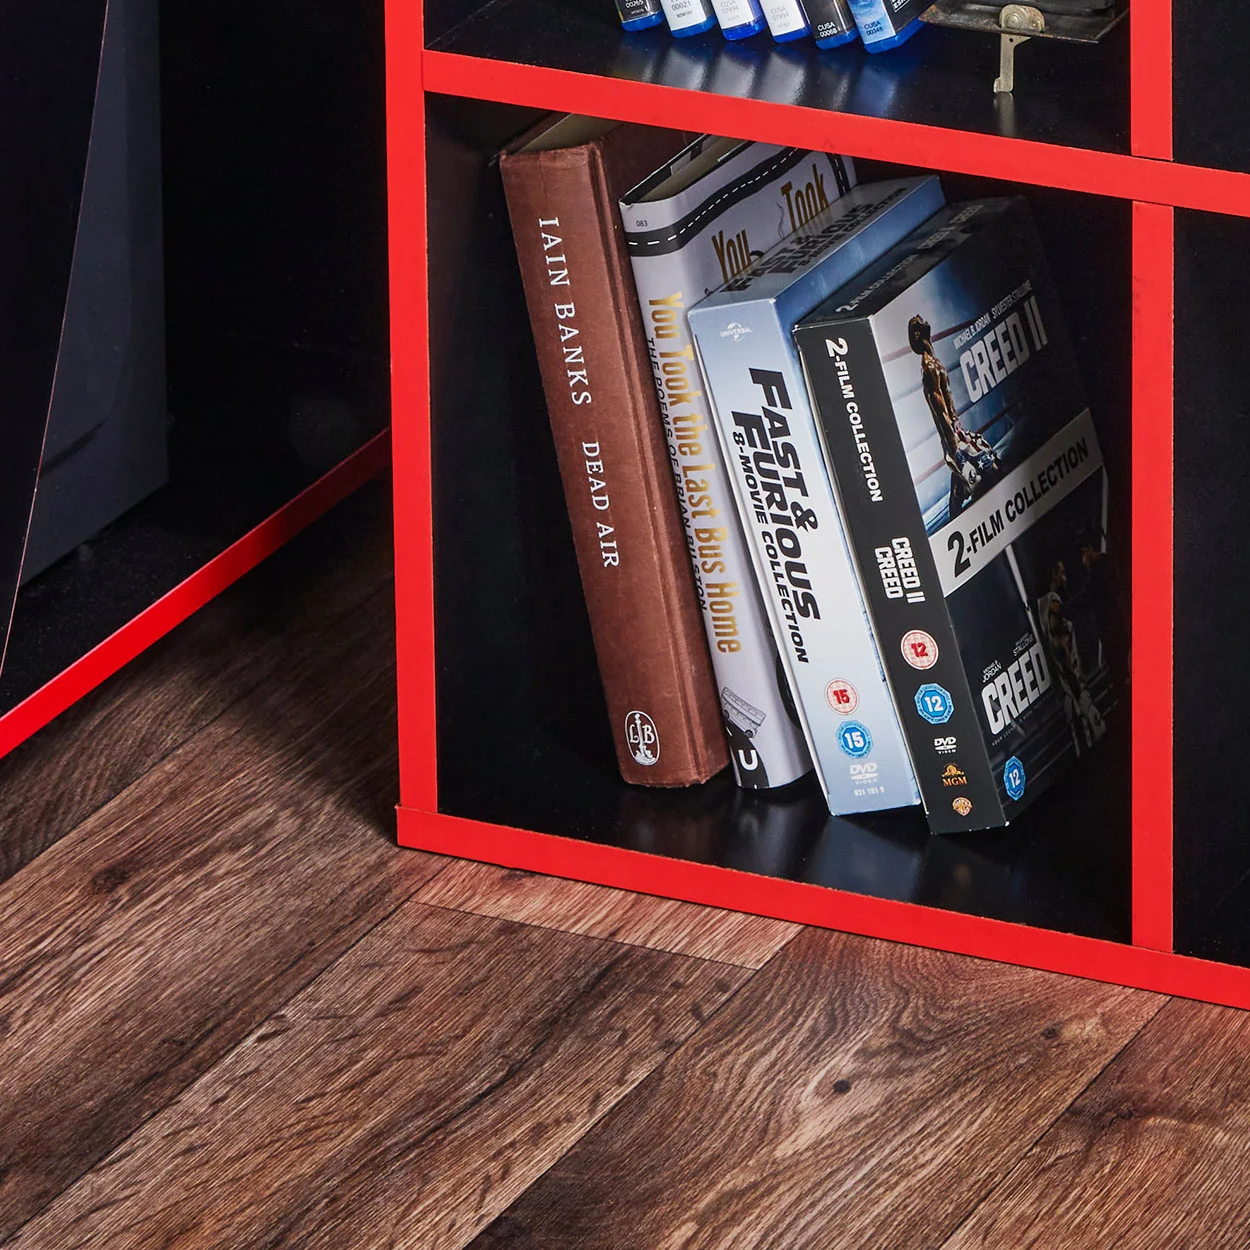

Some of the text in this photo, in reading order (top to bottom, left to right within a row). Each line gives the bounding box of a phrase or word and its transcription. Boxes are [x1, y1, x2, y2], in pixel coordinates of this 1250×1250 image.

[817, 21, 835, 31] CUSA
[538, 217, 592, 406] IAIN BANKS
[960, 294, 1048, 403] CREED II
[647, 337, 660, 371] THE
[654, 377, 673, 439] POEMS
[668, 444, 680, 467] OF
[825, 337, 884, 503] 2-FILM COLLECTION
[649, 291, 742, 654] You Took the Last Bus Home
[748, 367, 819, 533] FAST &
[582, 441, 620, 568] DEAD AIR
[731, 410, 821, 620] FURIOUS
[947, 437, 1089, 578] 2-FILM COLLECTION
[732, 431, 809, 663] 8-MOVIE COLLECTION
[874, 546, 904, 599] CREED
[891, 536, 926, 604] CREED II
[910, 642, 929, 658] 12
[981, 640, 1051, 735] CREED
[833, 688, 850, 705] 15
[924, 695, 944, 713] 12
[844, 731, 865, 749] 15
[850, 763, 877, 775] DVD
[934, 736, 957, 747] DVD
[1008, 768, 1021, 789] 12
[942, 776, 968, 787] MGM
